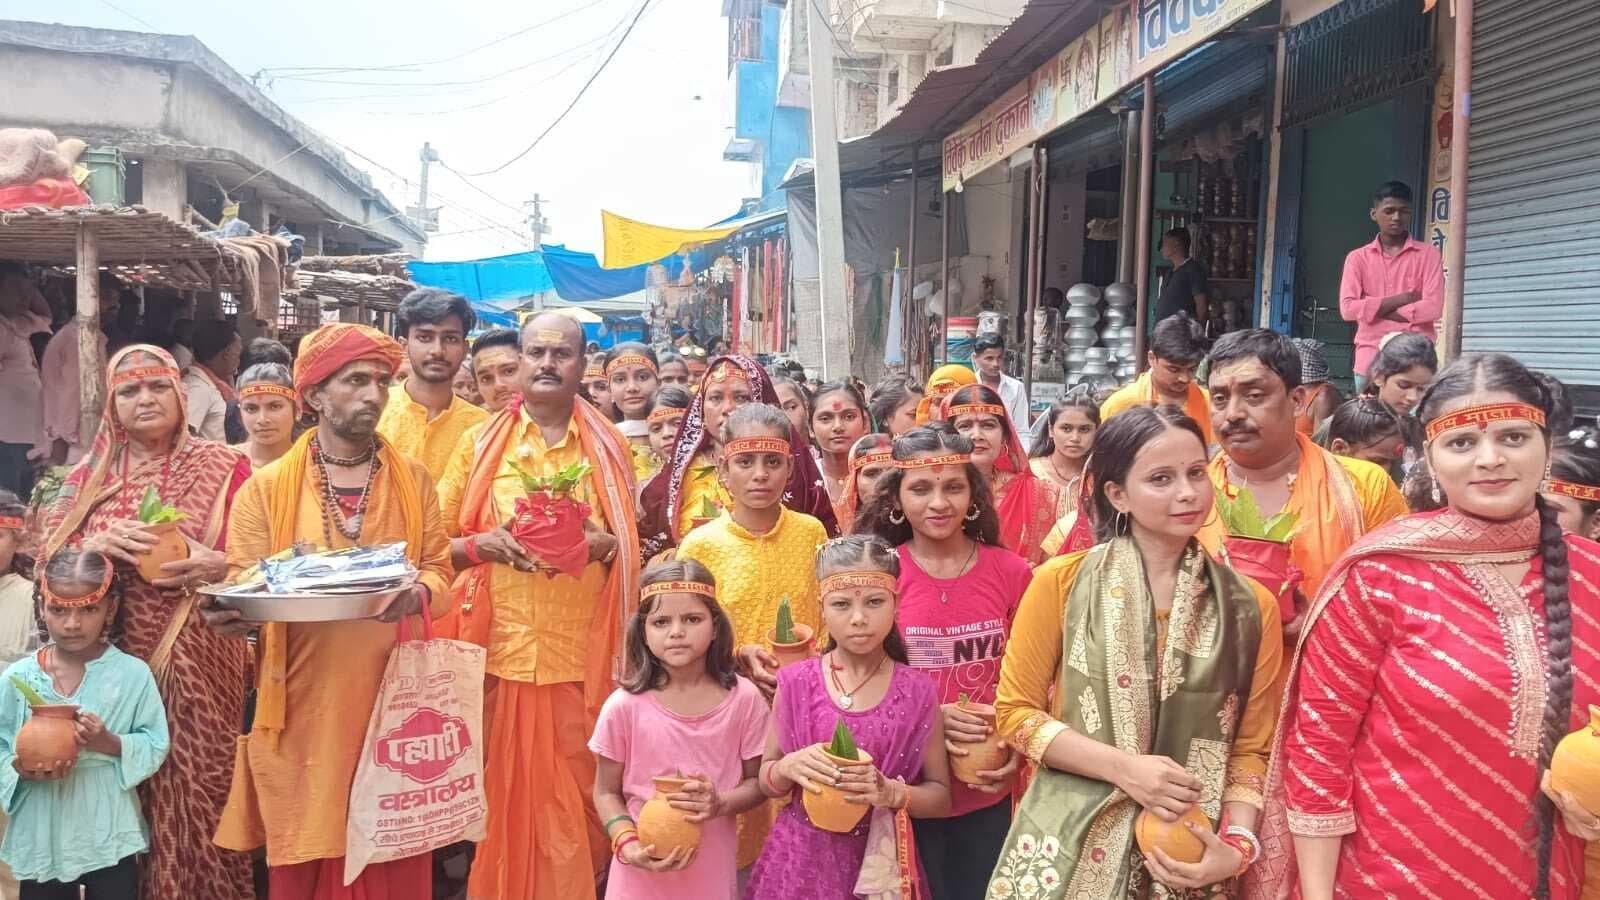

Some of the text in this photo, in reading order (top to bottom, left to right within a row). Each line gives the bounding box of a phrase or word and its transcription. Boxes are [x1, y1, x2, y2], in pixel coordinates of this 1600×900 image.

[1463, 408, 1512, 424] माता
[905, 626, 945, 636] ORIGINAL
[946, 622, 984, 635] VINTAGE
[377, 775, 476, 812] वस्त्रालय
